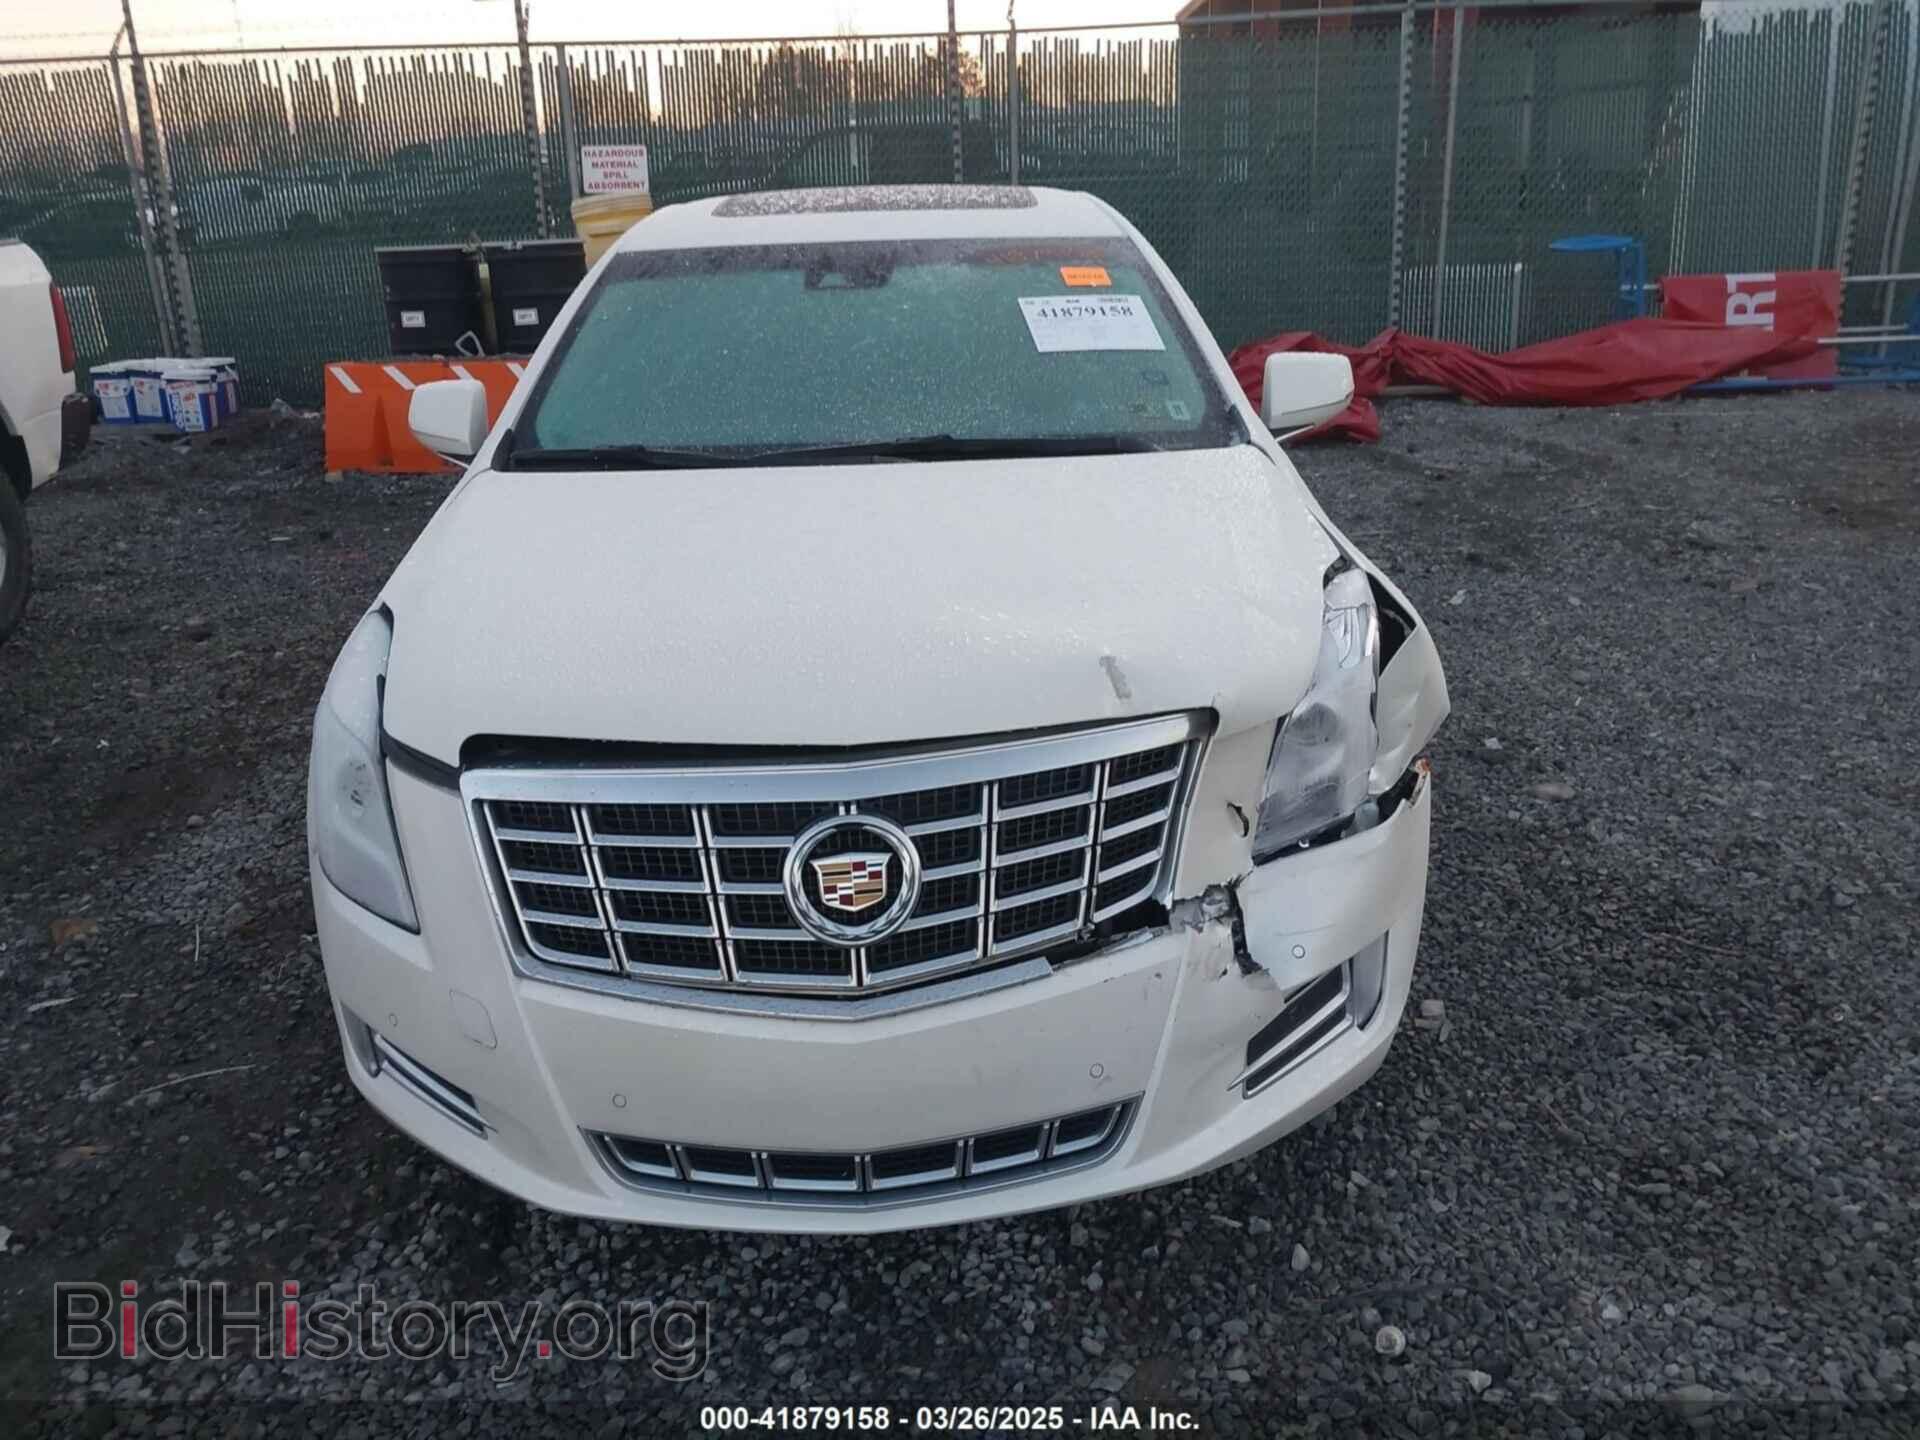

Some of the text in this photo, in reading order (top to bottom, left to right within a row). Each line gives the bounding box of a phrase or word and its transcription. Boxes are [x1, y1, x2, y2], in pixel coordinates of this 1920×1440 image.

[584, 149, 645, 158] HAZARDOUS
[591, 160, 640, 169] MATERIAL
[603, 170, 628, 179] SPILL
[588, 181, 646, 190] ABSORBENT
[1037, 304, 1134, 319] 41879158
